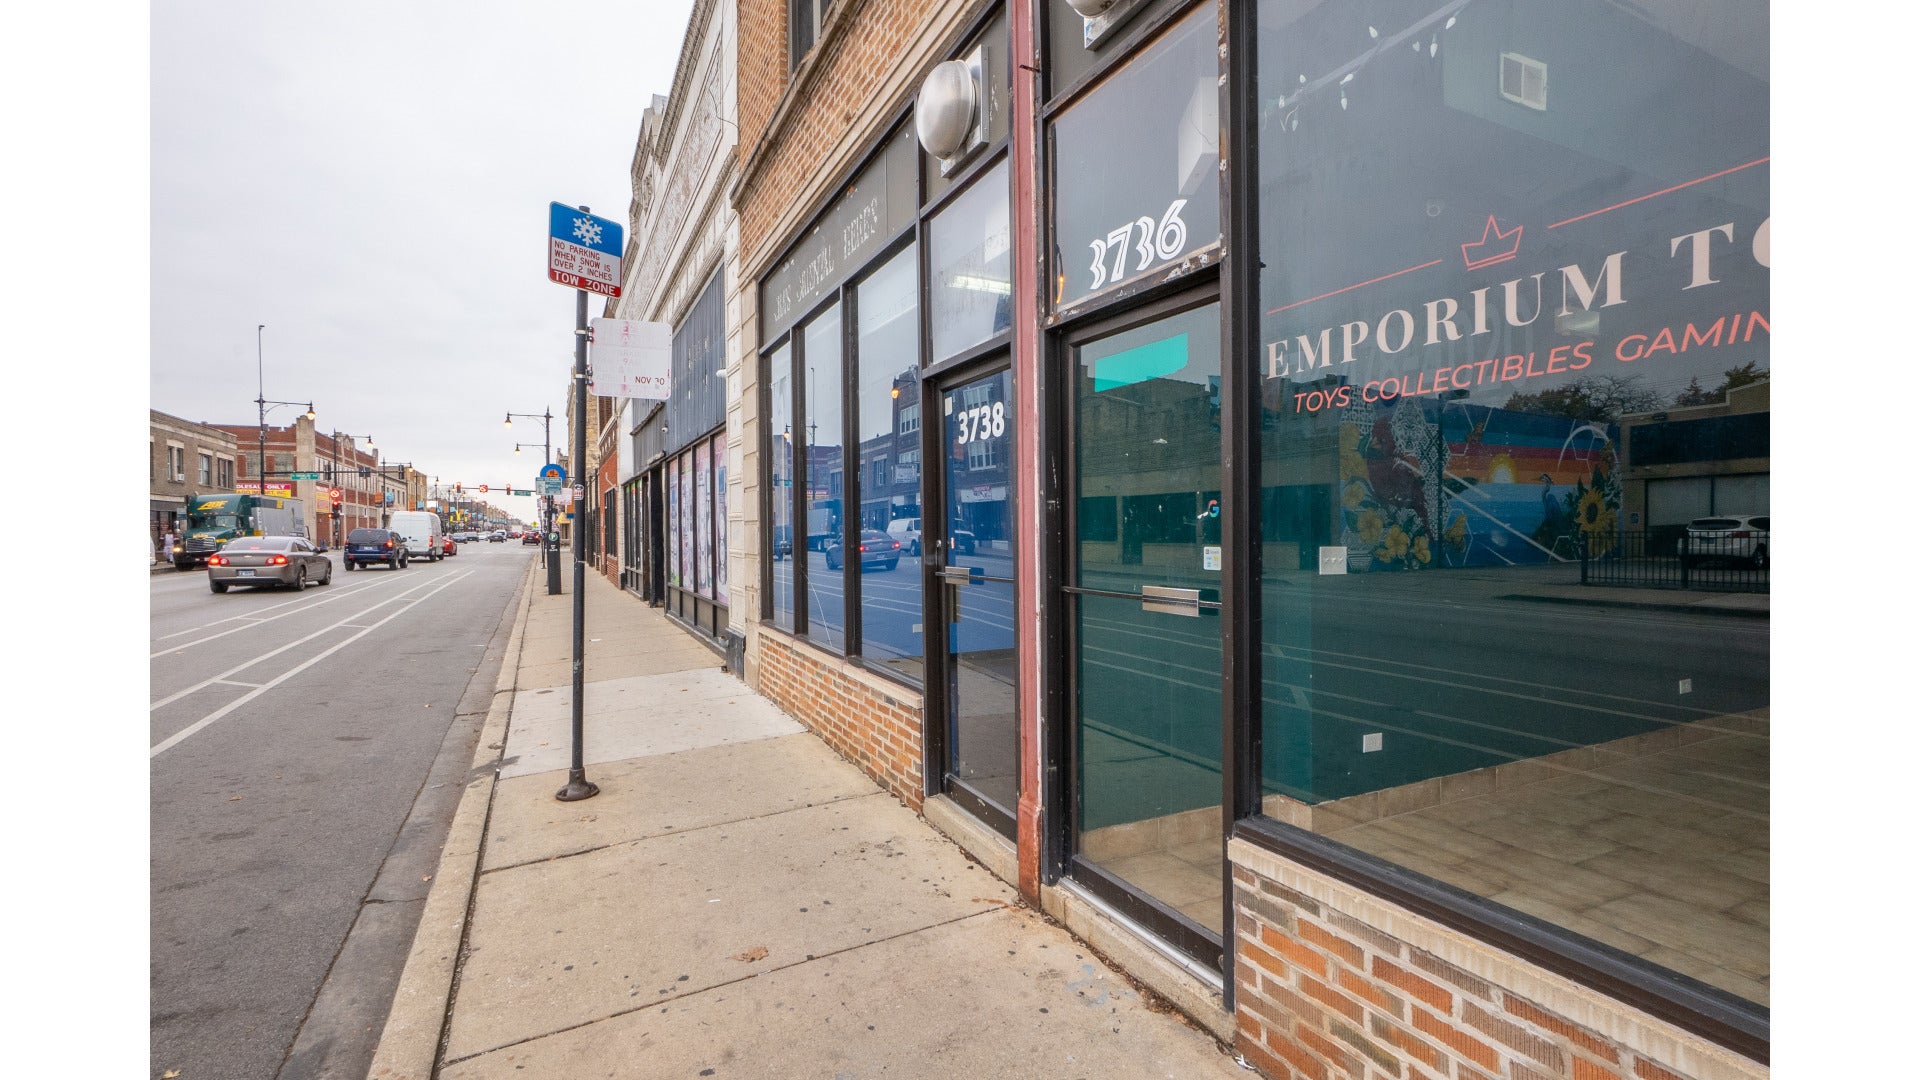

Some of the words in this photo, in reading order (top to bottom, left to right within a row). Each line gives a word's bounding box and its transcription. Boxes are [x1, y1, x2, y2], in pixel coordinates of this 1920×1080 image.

[554, 240, 566, 251] NO
[569, 244, 600, 261] PARKING
[1089, 199, 1188, 290] 3736
[554, 249, 576, 263] WHEN
[580, 256, 601, 270] SNOW
[603, 263, 611, 273] IS
[554, 258, 574, 271] OVER
[578, 265, 584, 274] 2
[587, 267, 613, 282] INCHES
[554, 270, 580, 287] TOW
[584, 278, 616, 297] ZONE
[1266, 250, 1628, 380] EMPORIUM
[1669, 214, 1770, 292] T
[635, 376, 652, 385] NOV
[1293, 386, 1350, 415] TOYS
[1361, 342, 1594, 405] COLLECTIBLES
[958, 401, 1005, 445] 3738
